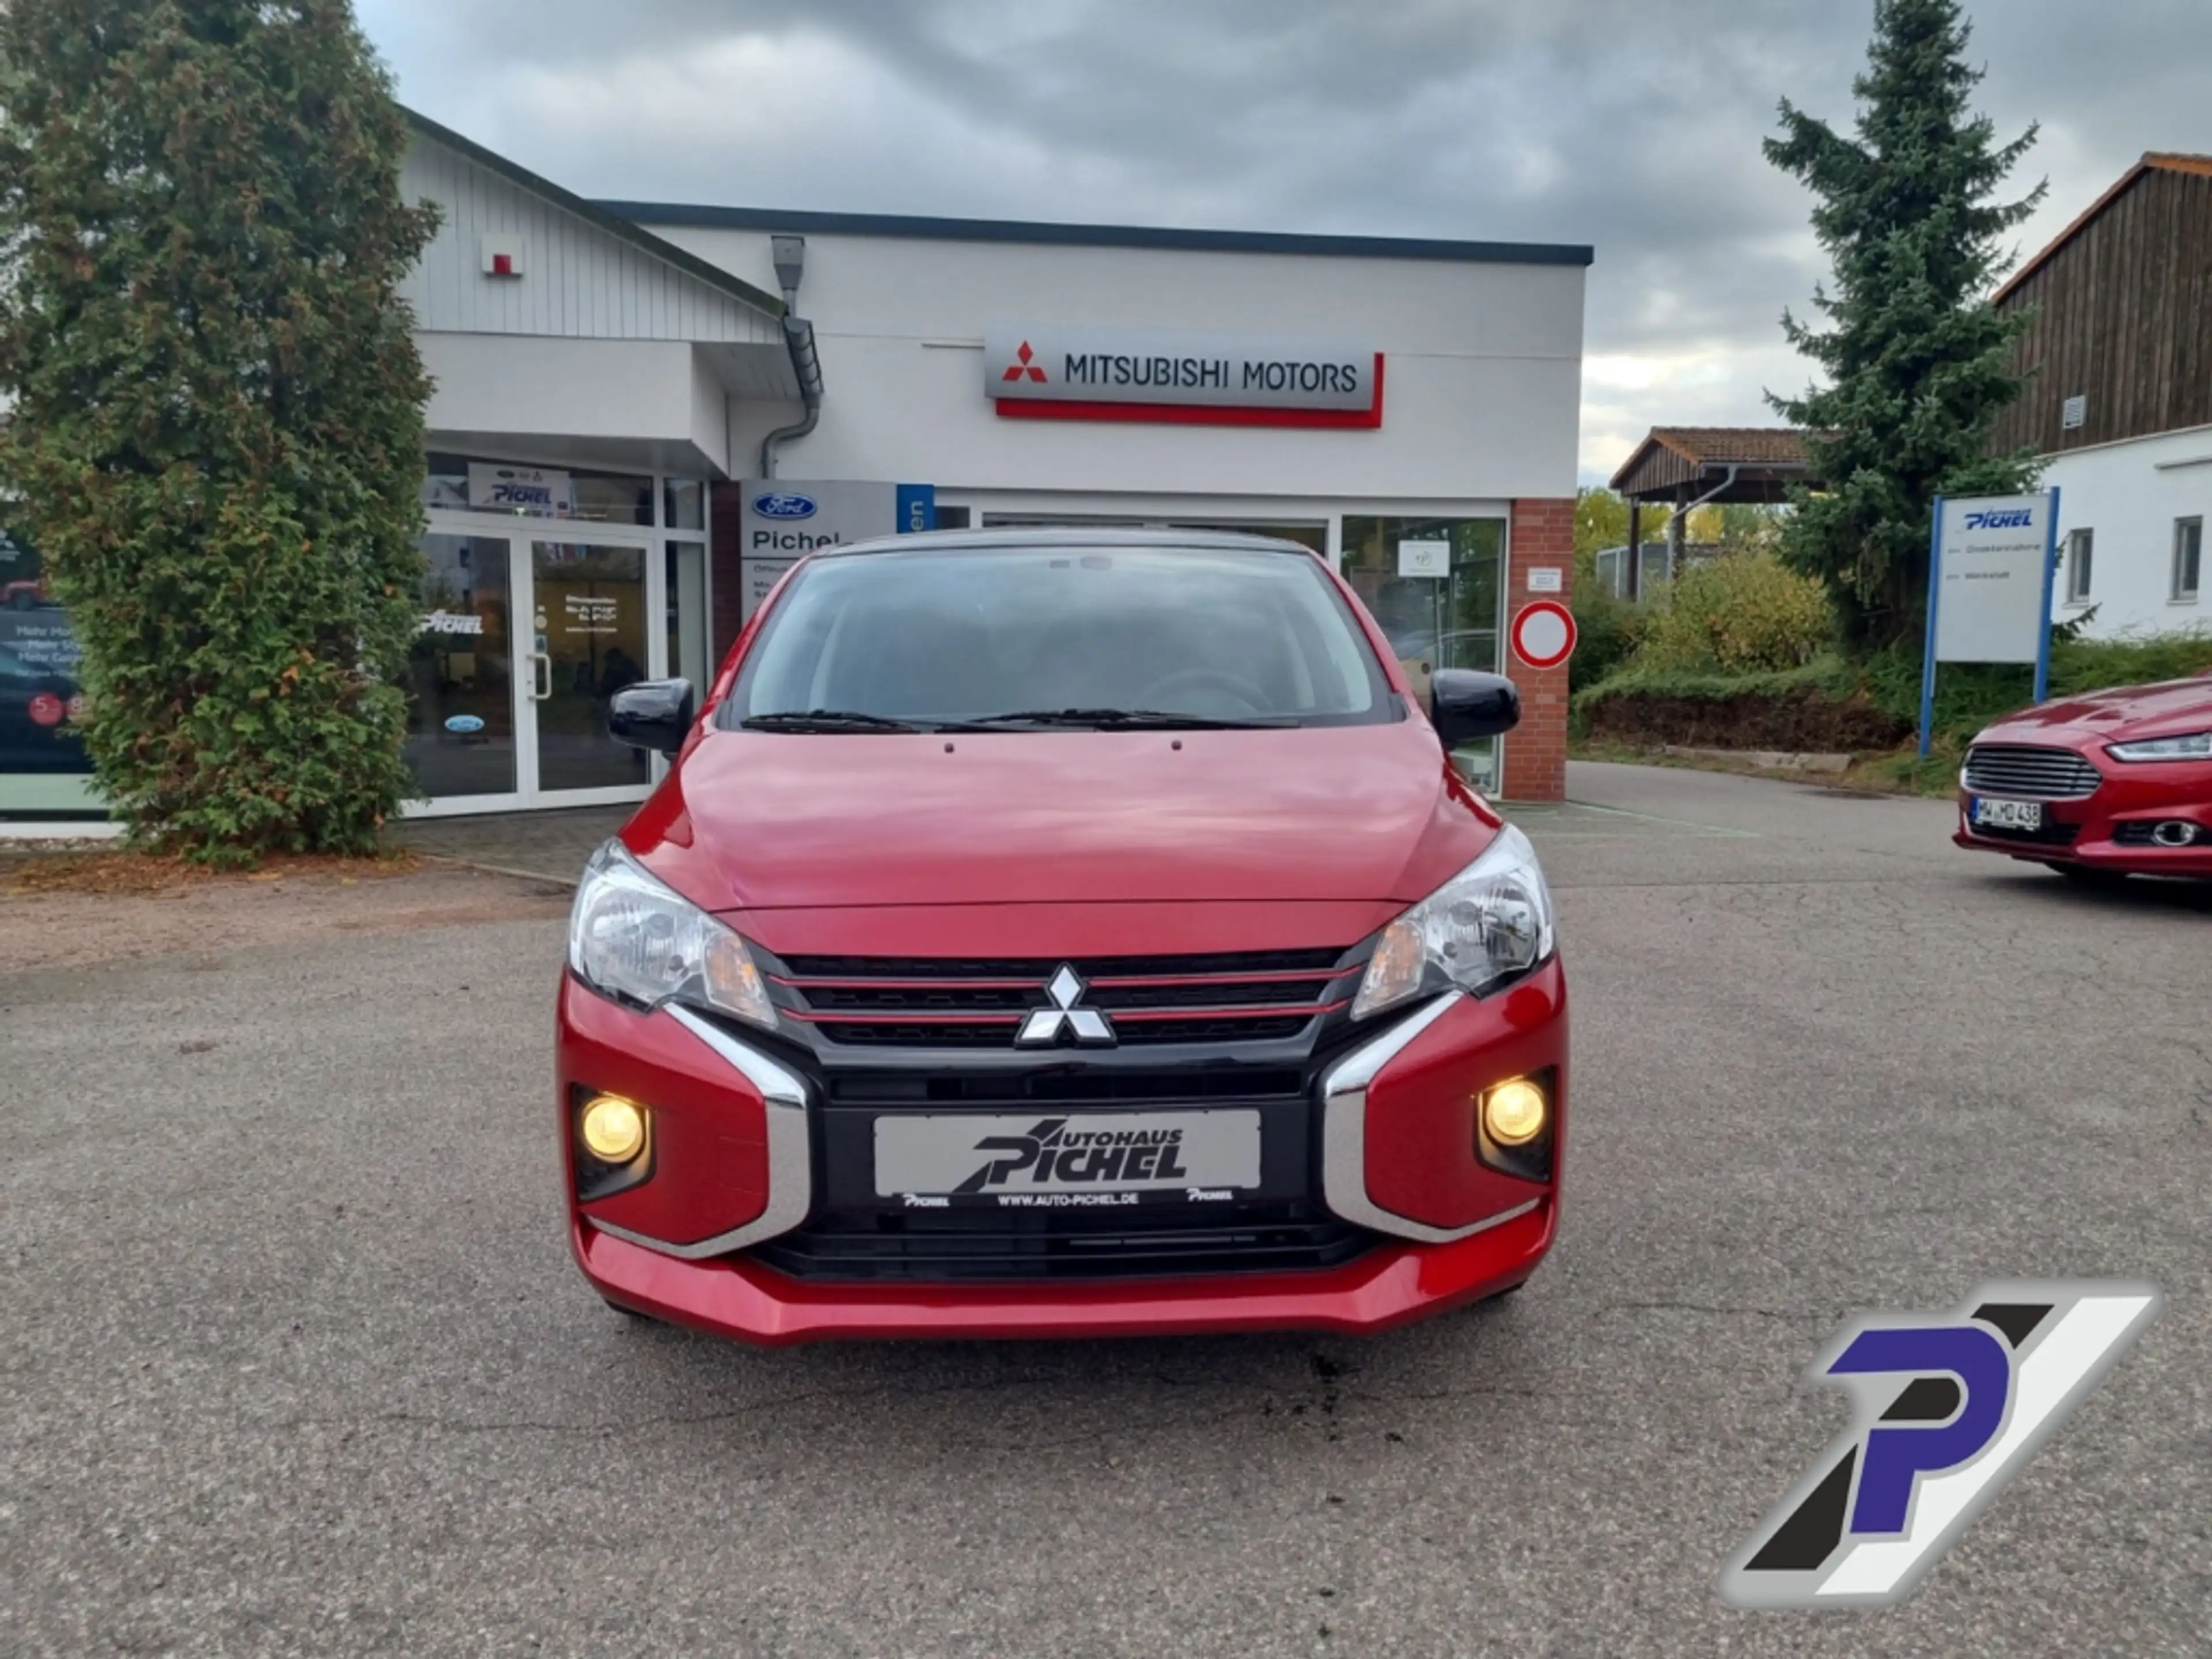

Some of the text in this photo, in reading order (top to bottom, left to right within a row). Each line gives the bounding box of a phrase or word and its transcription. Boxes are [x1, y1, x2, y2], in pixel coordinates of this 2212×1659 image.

[1065, 353, 1357, 392] MITSUBISHI MOTORS
[491, 484, 552, 505] PICHEL
[765, 493, 805, 514] Ford
[1964, 511, 2032, 530] PICHEL
[2017, 805, 2039, 824] 438
[1041, 1128, 1183, 1148] AUTOHAUS
[972, 1136, 1187, 1184] PICHEL
[903, 1187, 1233, 1209] PICHEL WWW.AUTO-PICHEL.DE PICHEL
